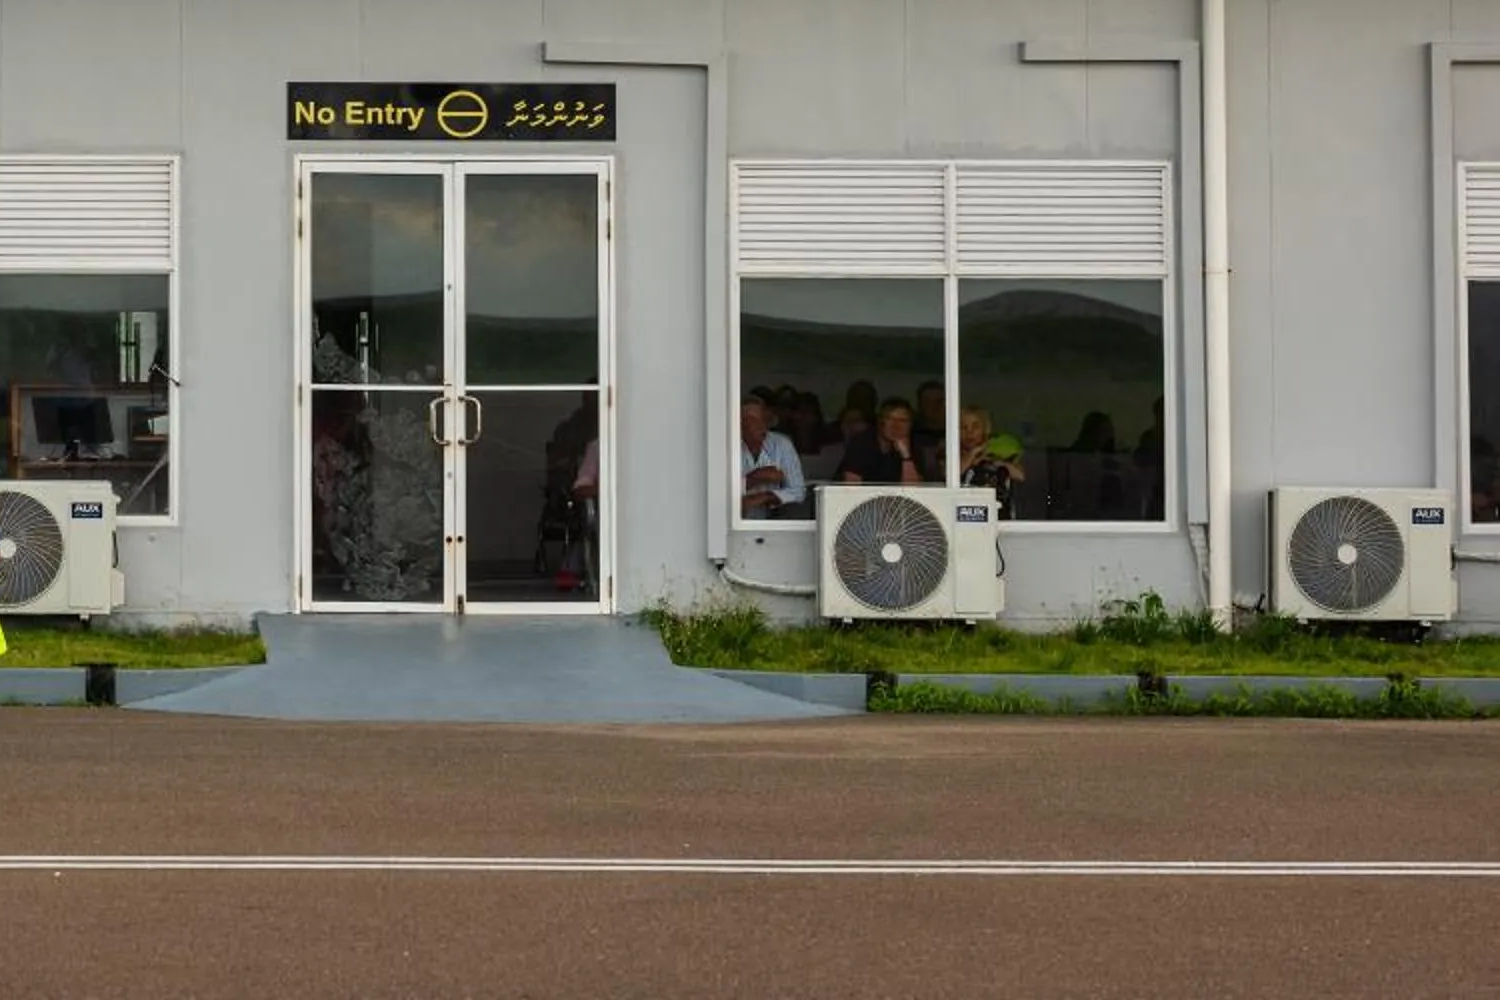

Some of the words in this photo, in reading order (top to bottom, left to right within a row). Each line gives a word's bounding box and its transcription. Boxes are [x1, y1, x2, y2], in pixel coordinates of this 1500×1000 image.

[295, 101, 336, 125] No
[345, 101, 425, 131] Entry
[73, 503, 100, 513] AUX
[1415, 508, 1442, 518] AUX
